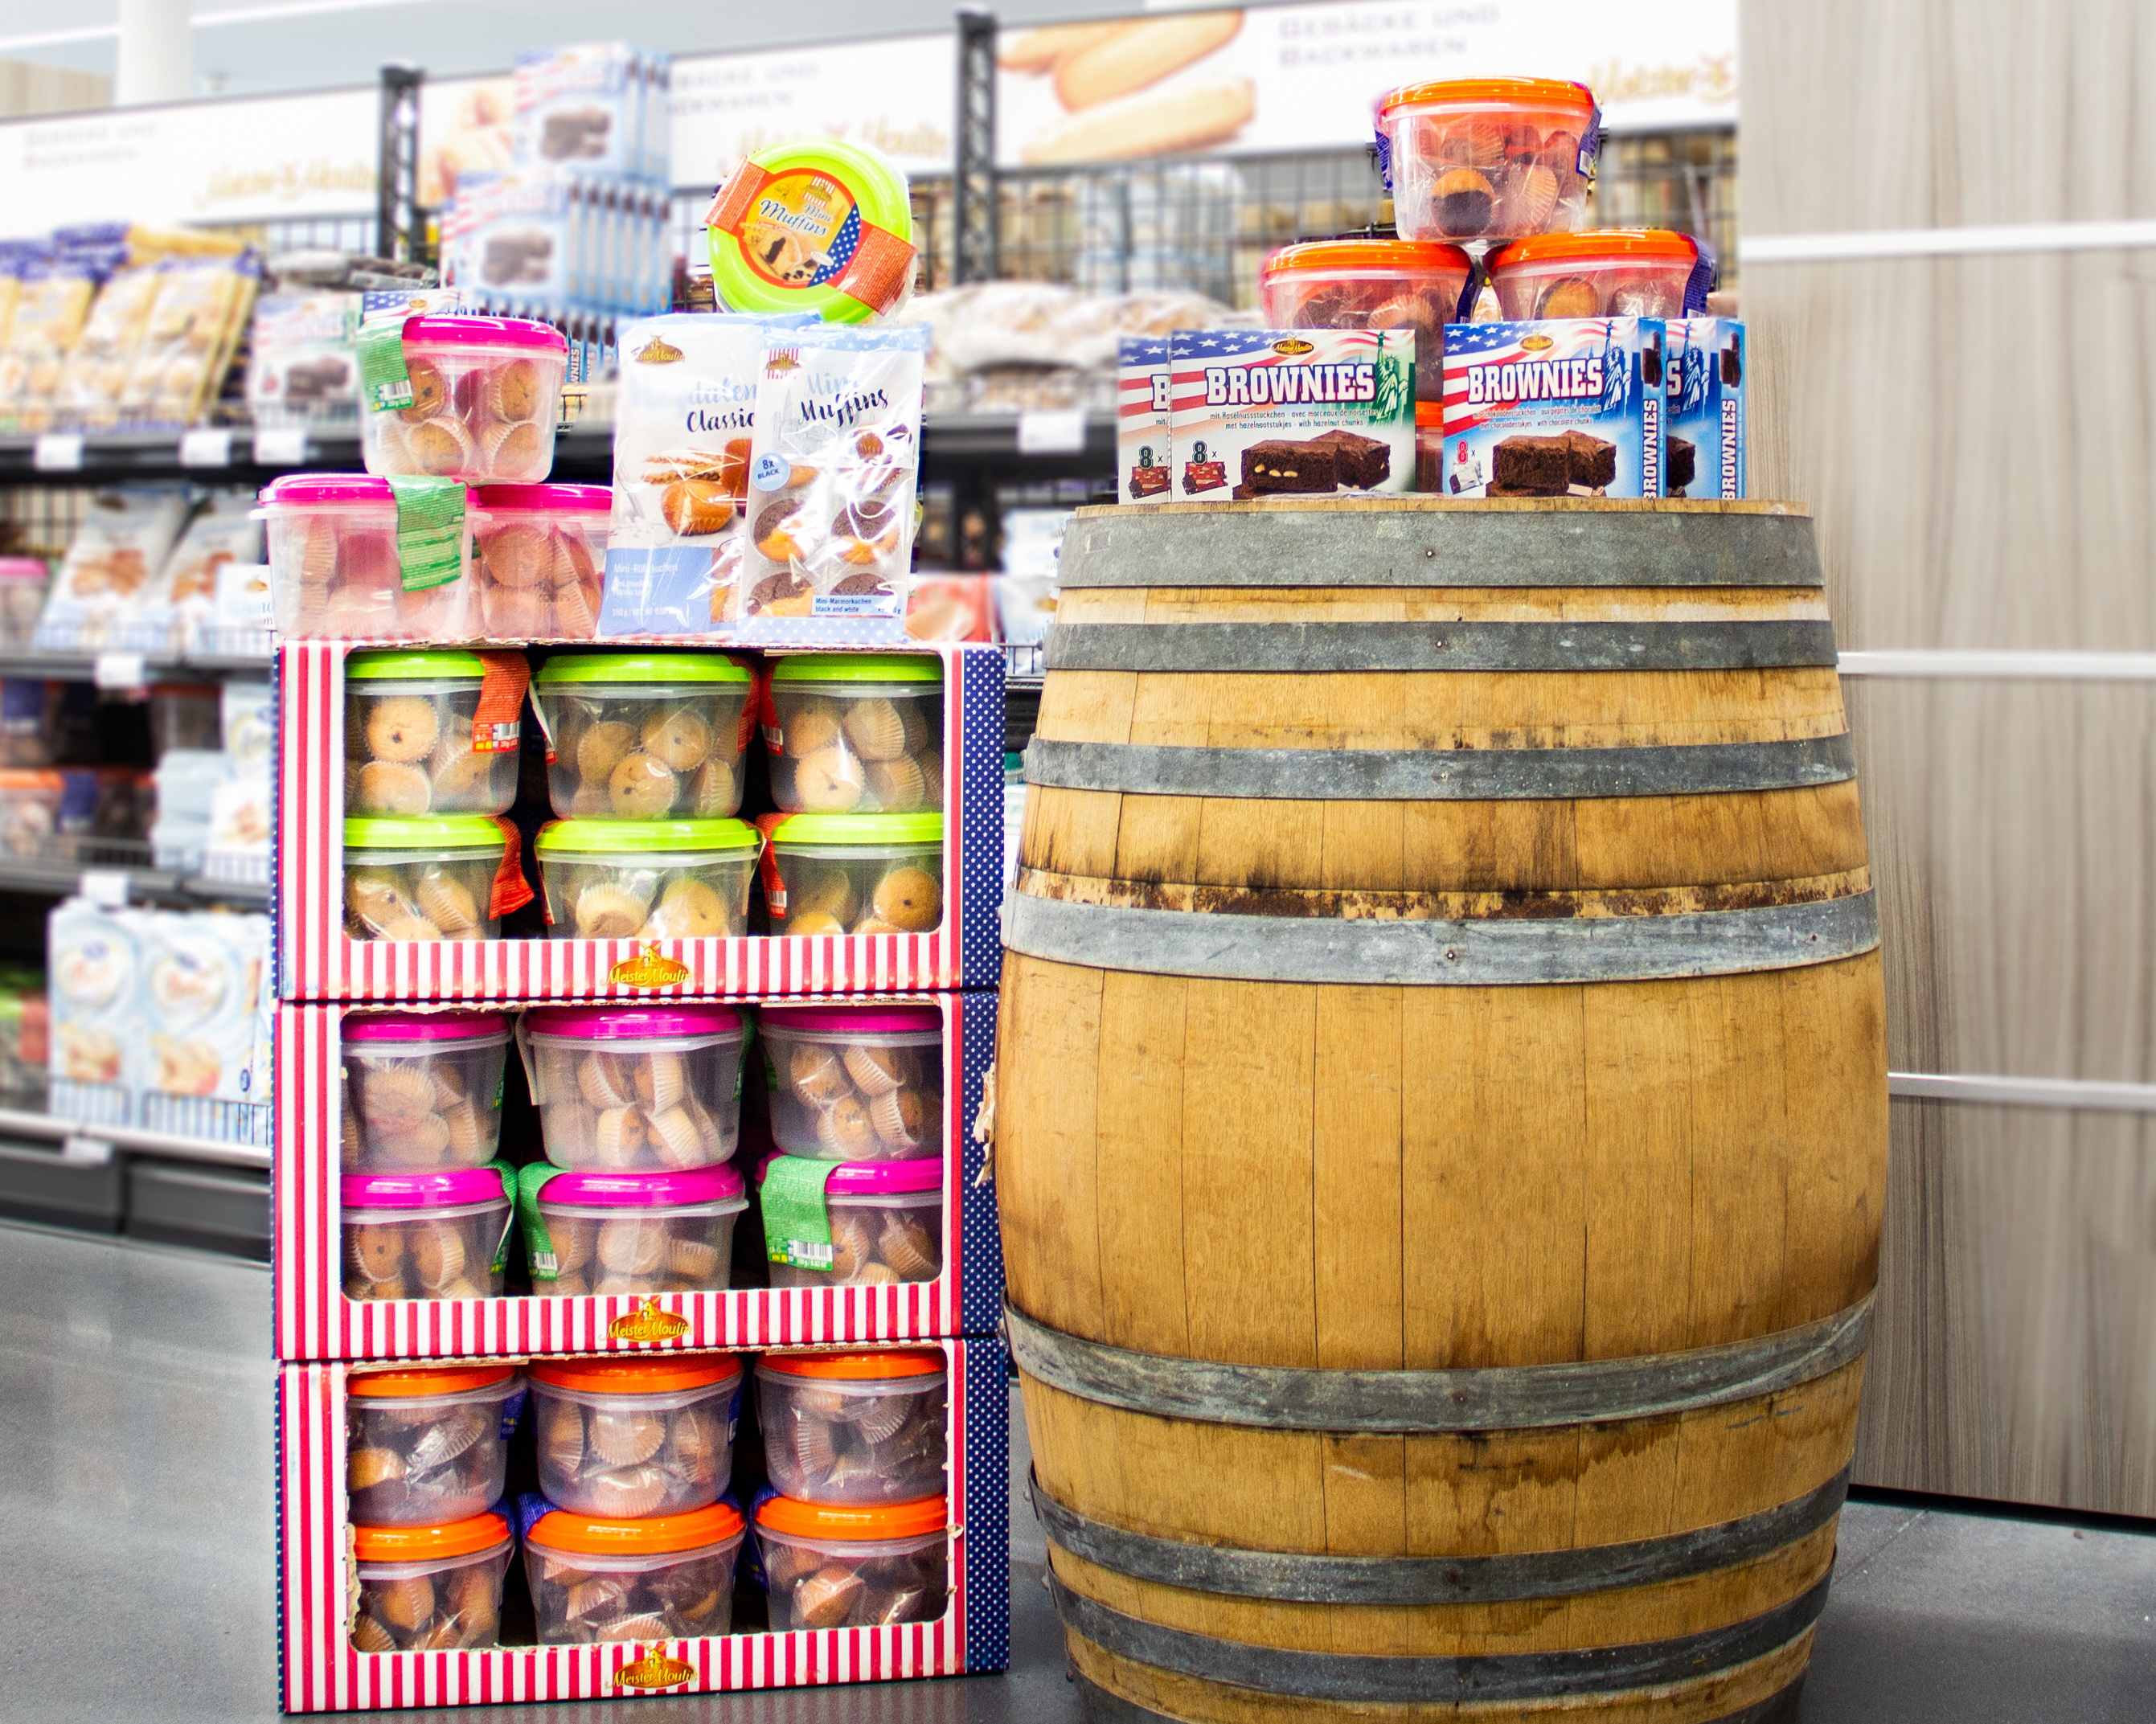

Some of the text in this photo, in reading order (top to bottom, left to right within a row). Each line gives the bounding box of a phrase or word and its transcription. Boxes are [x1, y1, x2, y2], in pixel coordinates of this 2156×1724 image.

[761, 199, 827, 235] Muffins
[805, 204, 834, 222] Mini
[1205, 363, 1376, 405] BROWNIES
[1468, 358, 1604, 404] BROWNIES
[687, 407, 754, 432] Classic
[798, 389, 889, 428] Muffins
[1210, 412, 1221, 420] mit
[1225, 421, 1237, 429] met
[1342, 418, 1363, 426] chunks
[1138, 445, 1153, 469] 8
[1192, 440, 1207, 465] 8
[1457, 440, 1468, 465] 8
[1642, 398, 1658, 499] BROWNIES
[1721, 398, 1737, 500] BROWNIES
[758, 469, 779, 480] BLACK
[601, 967, 692, 986] Meister Moulin
[599, 1320, 692, 1340] Meister Moulin
[605, 1669, 653, 1688] Meister
